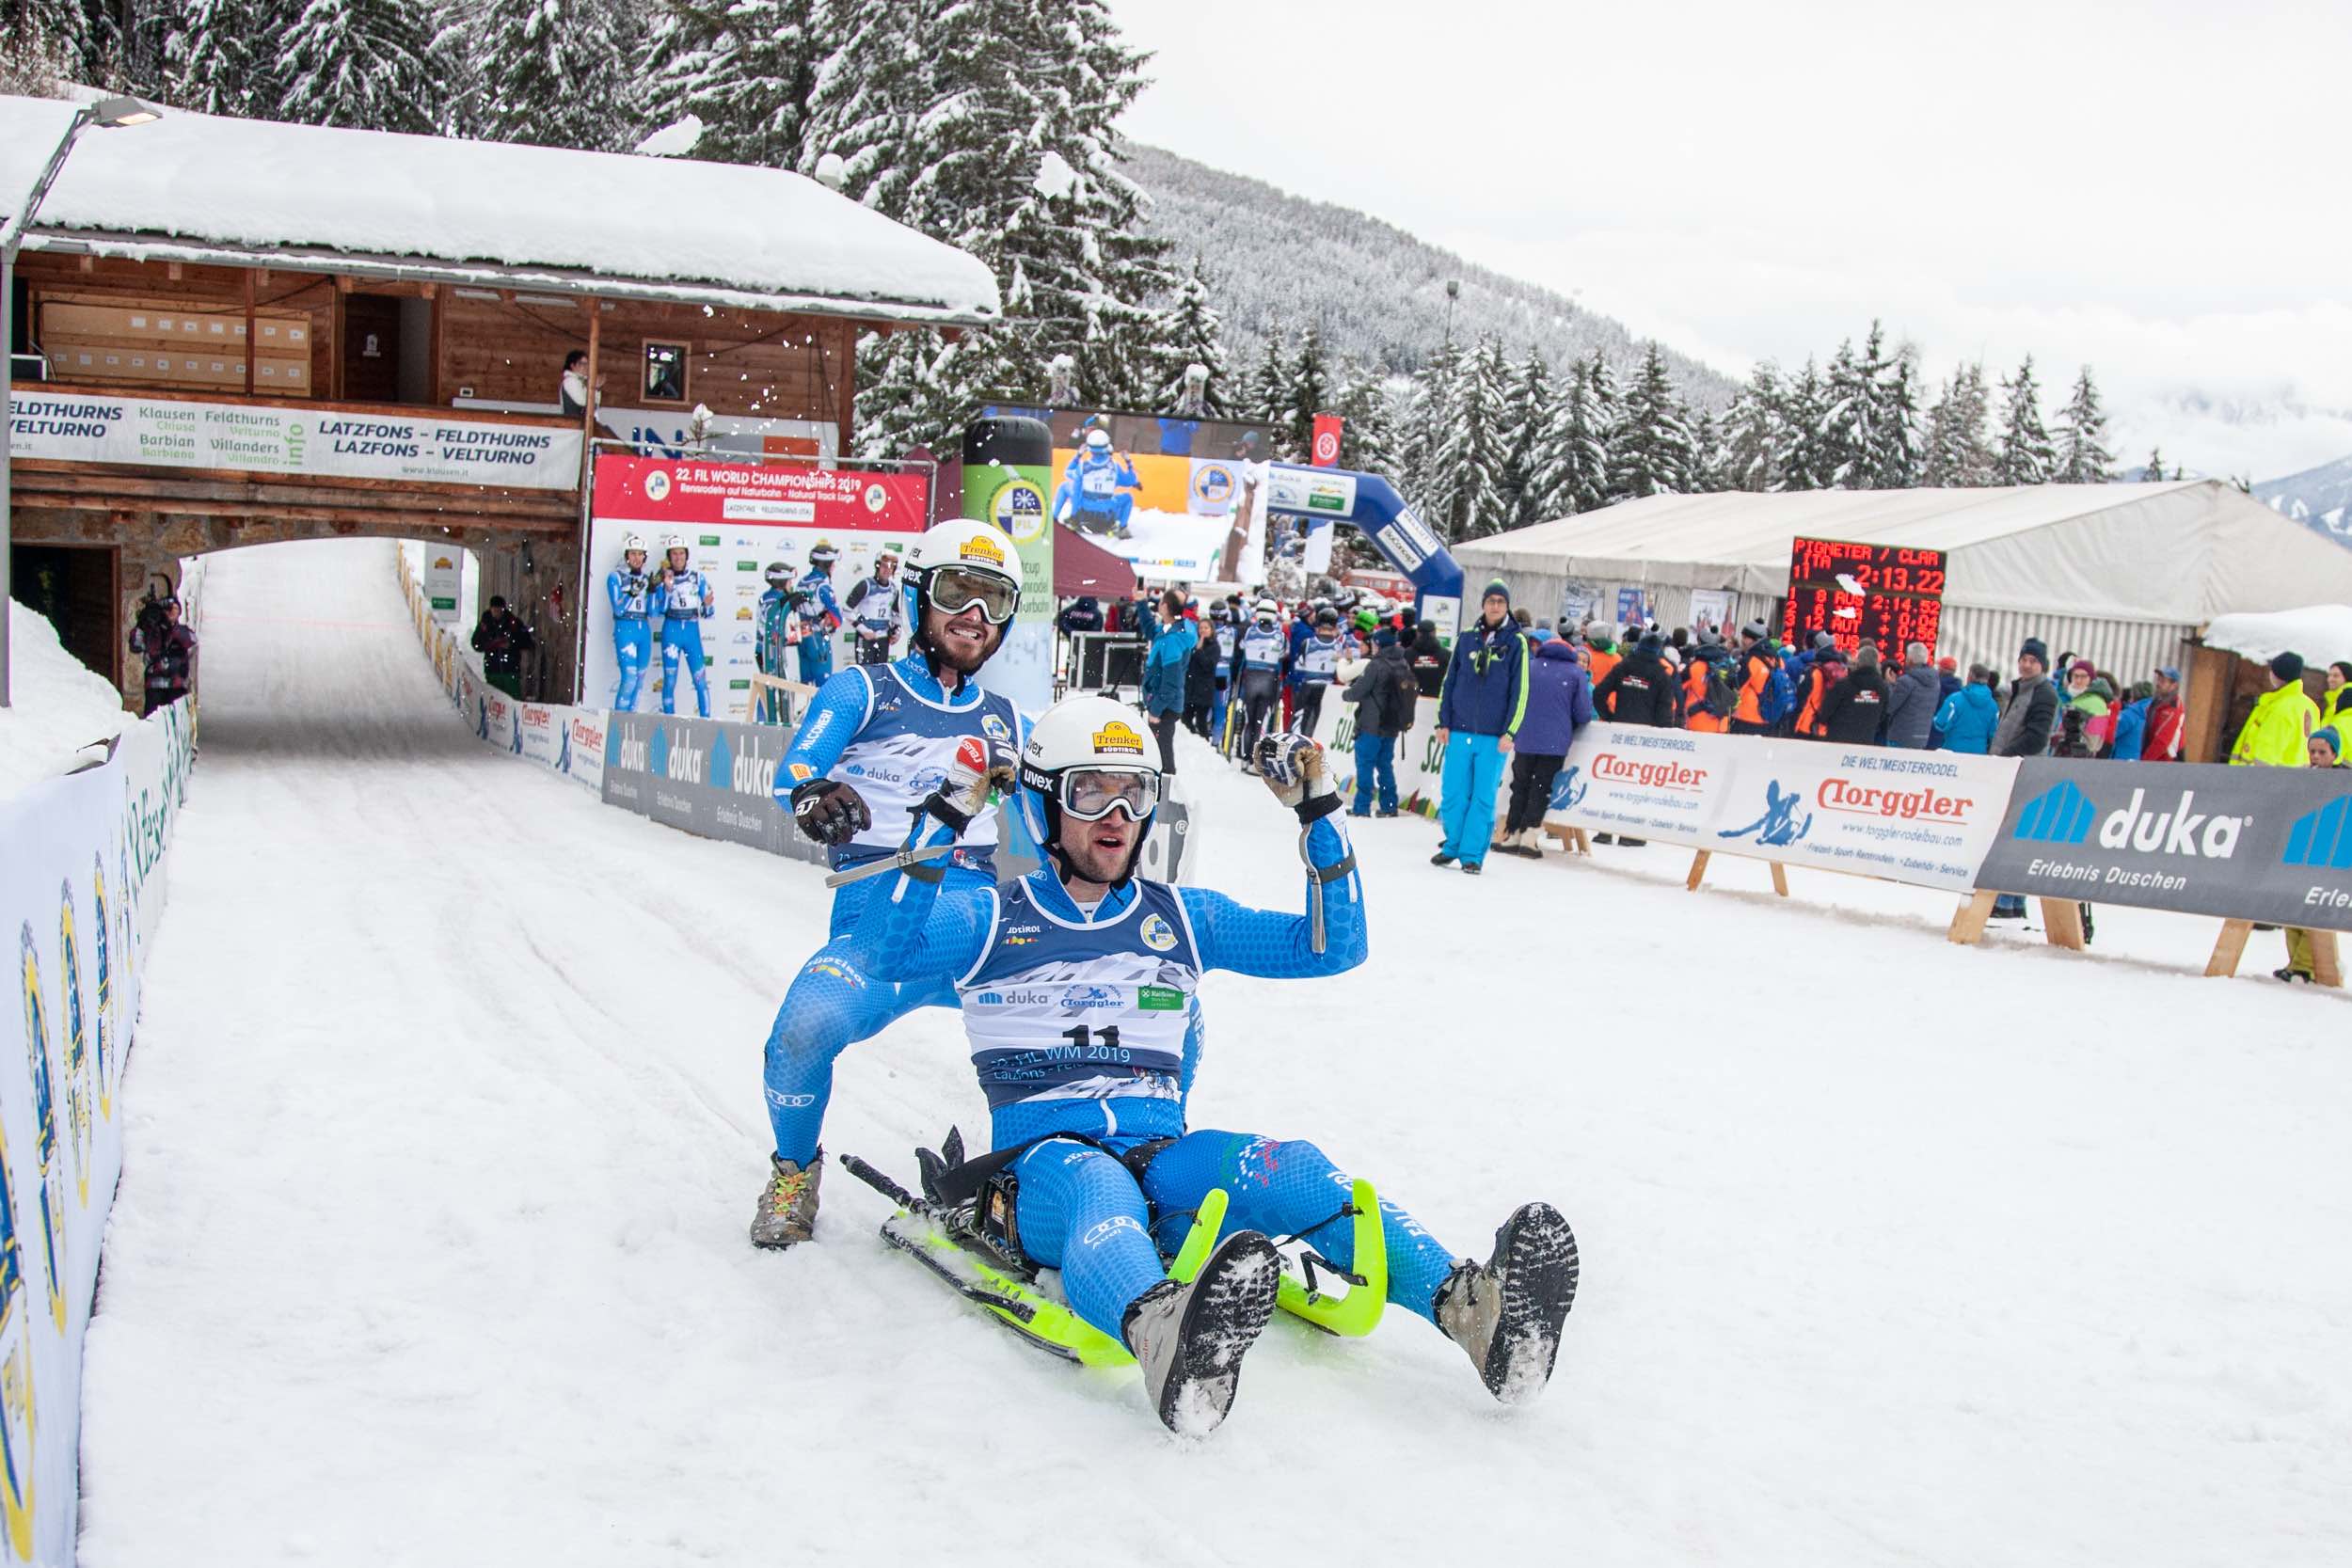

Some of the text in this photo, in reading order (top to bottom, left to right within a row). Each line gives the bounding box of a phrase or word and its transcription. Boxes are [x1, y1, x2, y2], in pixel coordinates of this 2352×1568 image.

[139, 406, 196, 421] Klausen
[205, 410, 281, 427] Feldthurns
[156, 420, 196, 433] Chiusa
[230, 425, 280, 438] Velturno
[319, 420, 413, 439] LATZFONS
[435, 428, 551, 449] FELDTHURNS
[140, 434, 196, 449] Barbian
[211, 438, 280, 454] Villanders
[142, 447, 196, 460] Barbiano
[228, 453, 279, 467] Villandro
[334, 439, 420, 457] LAZFONS
[442, 446, 535, 466] VELTURNO
[675, 467, 862, 493] 22. FIL WORLD CHAMPIONSHIPS 2019
[962, 544, 1002, 559] Trenker
[1794, 539, 1872, 561] PIGNETER
[1804, 552, 1832, 570] ITA
[1793, 562, 1946, 595] 11 2:13.22
[635, 599, 642, 610] 6
[679, 597, 687, 608] 6
[1787, 600, 1798, 614] 2
[1815, 589, 1828, 604] 8
[1871, 594, 1941, 613] 2:14.52
[878, 608, 887, 618] 12
[1805, 614, 1825, 631] 12
[1831, 617, 1862, 633] AUT
[620, 721, 645, 773] duka
[1096, 734, 1142, 747] Trenker
[1611, 733, 1696, 752] DIE WELTMEISTERRODEL
[668, 727, 703, 784] duka
[1103, 746, 1138, 754] SÜDTIROL
[733, 735, 775, 799] duka
[1592, 752, 1708, 788] Torggler
[1841, 754, 1959, 778] DIE WELTMEISTERRODEL
[866, 768, 900, 783] duka
[1024, 768, 1055, 793] uvex
[1817, 778, 1975, 819] Torggler
[1940, 863, 1969, 878] Service
[2026, 858, 2187, 891] Erlebnis Duschen
[2305, 886, 2352, 909] Erle
[1006, 990, 1048, 1005] duka
[1060, 999, 1125, 1008] Torggler
[1062, 1024, 1120, 1047] 11
[1045, 1045, 1081, 1061] WM
[1087, 1046, 1131, 1063] 2019
